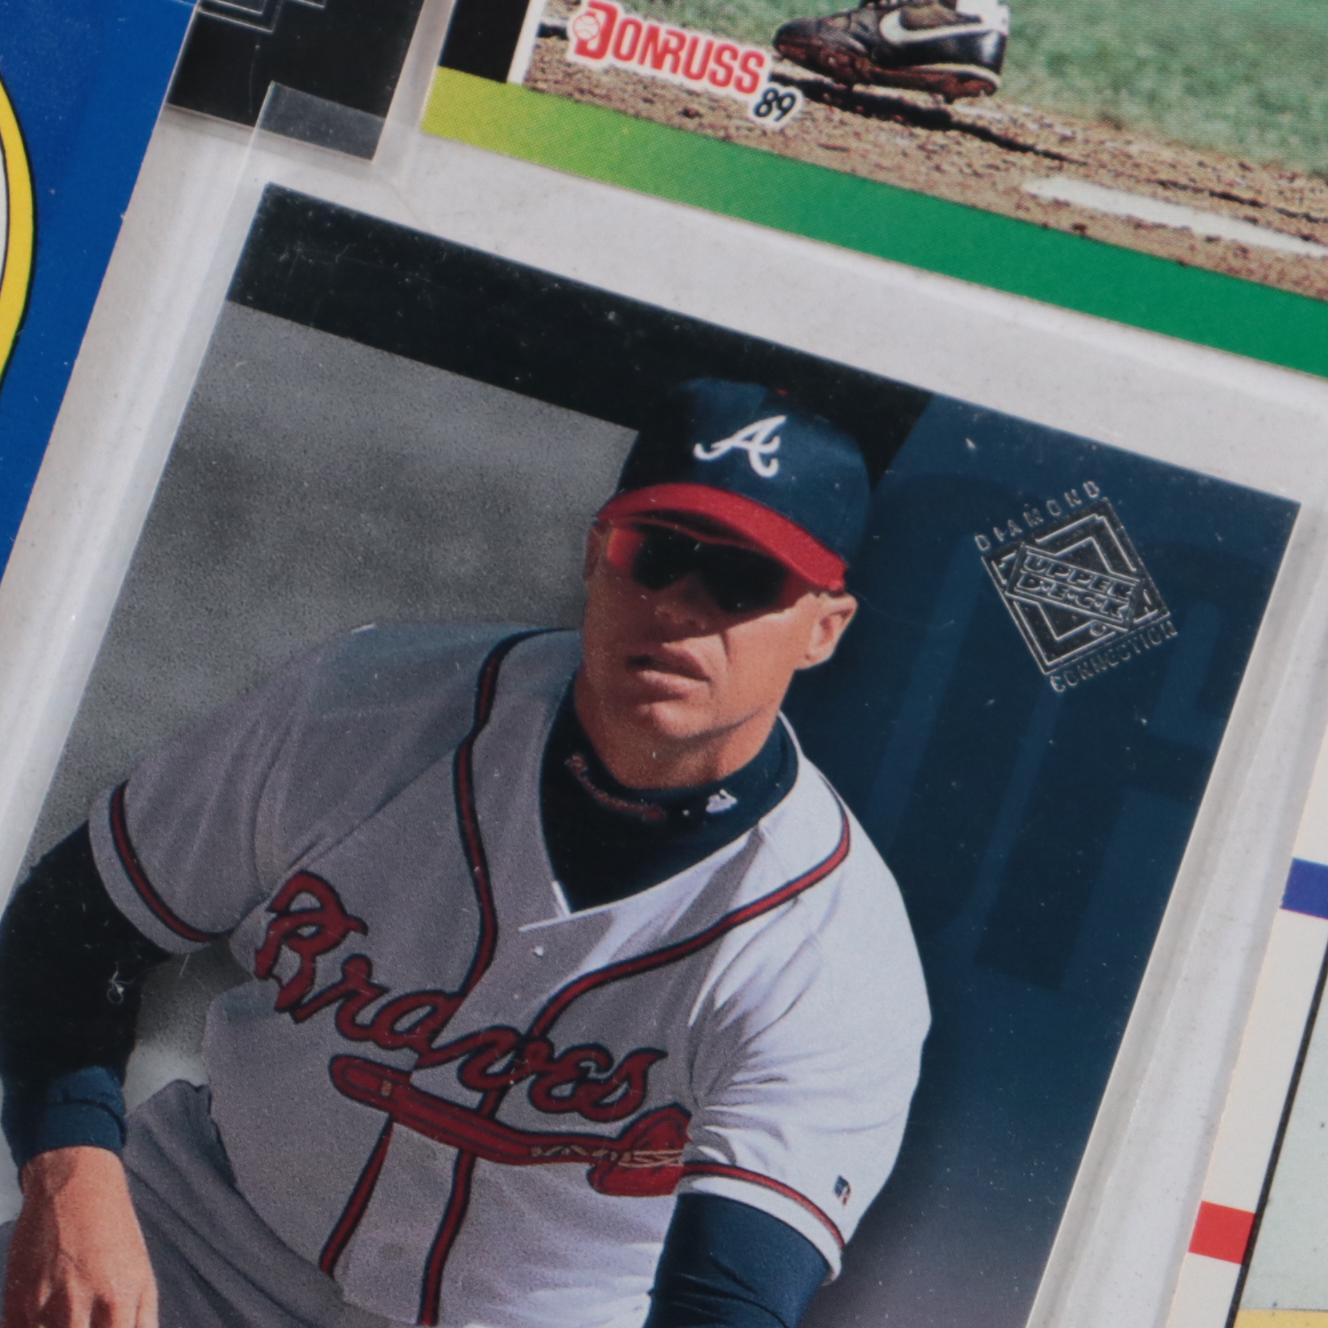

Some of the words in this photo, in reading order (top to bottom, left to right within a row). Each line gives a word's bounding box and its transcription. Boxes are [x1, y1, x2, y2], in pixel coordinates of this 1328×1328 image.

[573, 0, 766, 95] DONRUSS
[753, 87, 797, 122] 89
[694, 414, 787, 478] A
[974, 480, 1104, 551] DIAMOND
[1022, 554, 1136, 601] UPPER
[253, 869, 668, 1123] Braves
